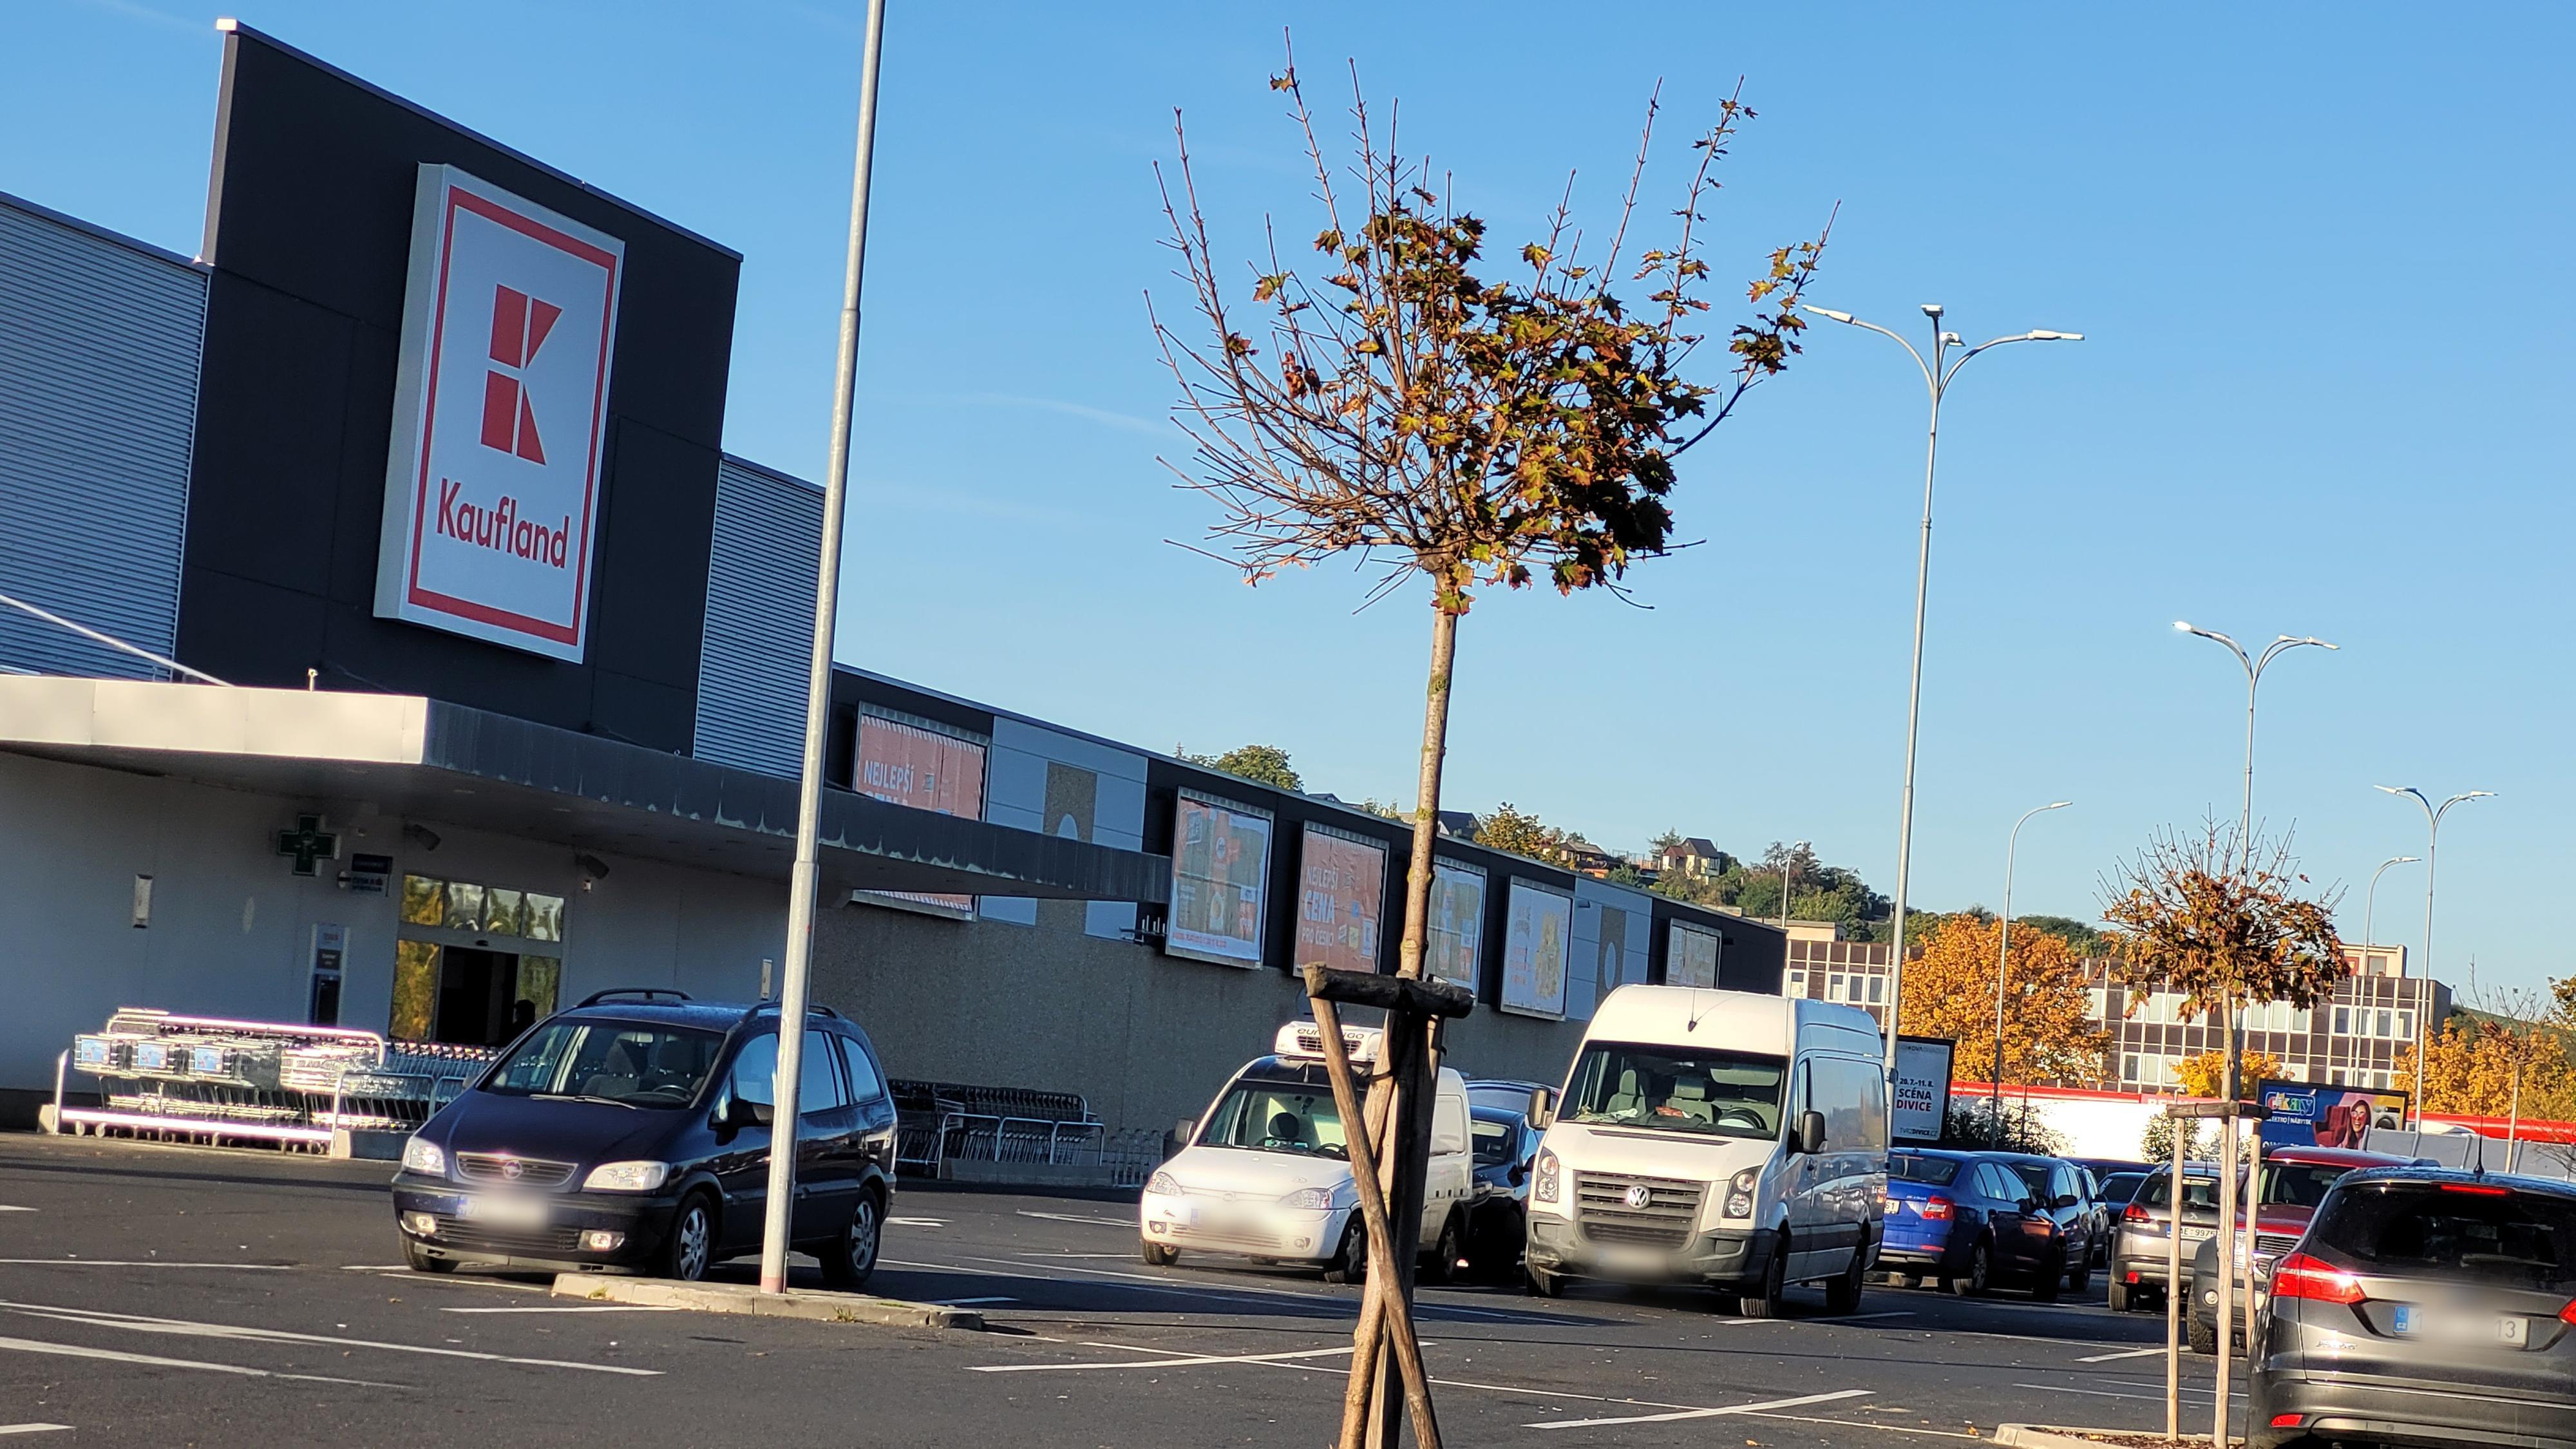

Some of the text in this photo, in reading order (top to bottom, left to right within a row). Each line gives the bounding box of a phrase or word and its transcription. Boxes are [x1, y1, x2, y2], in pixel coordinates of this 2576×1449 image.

[437, 478, 569, 569] Kaufland
[864, 759, 914, 794] NEJLEPŠÍ
[1306, 865, 1339, 891] NEJLEPŠÍ
[1303, 889, 1335, 925] CENA
[1302, 925, 1314, 944] PRO
[1896, 1099, 1932, 1112] DIVICE
[1898, 1087, 1932, 1101] SCÉNA
